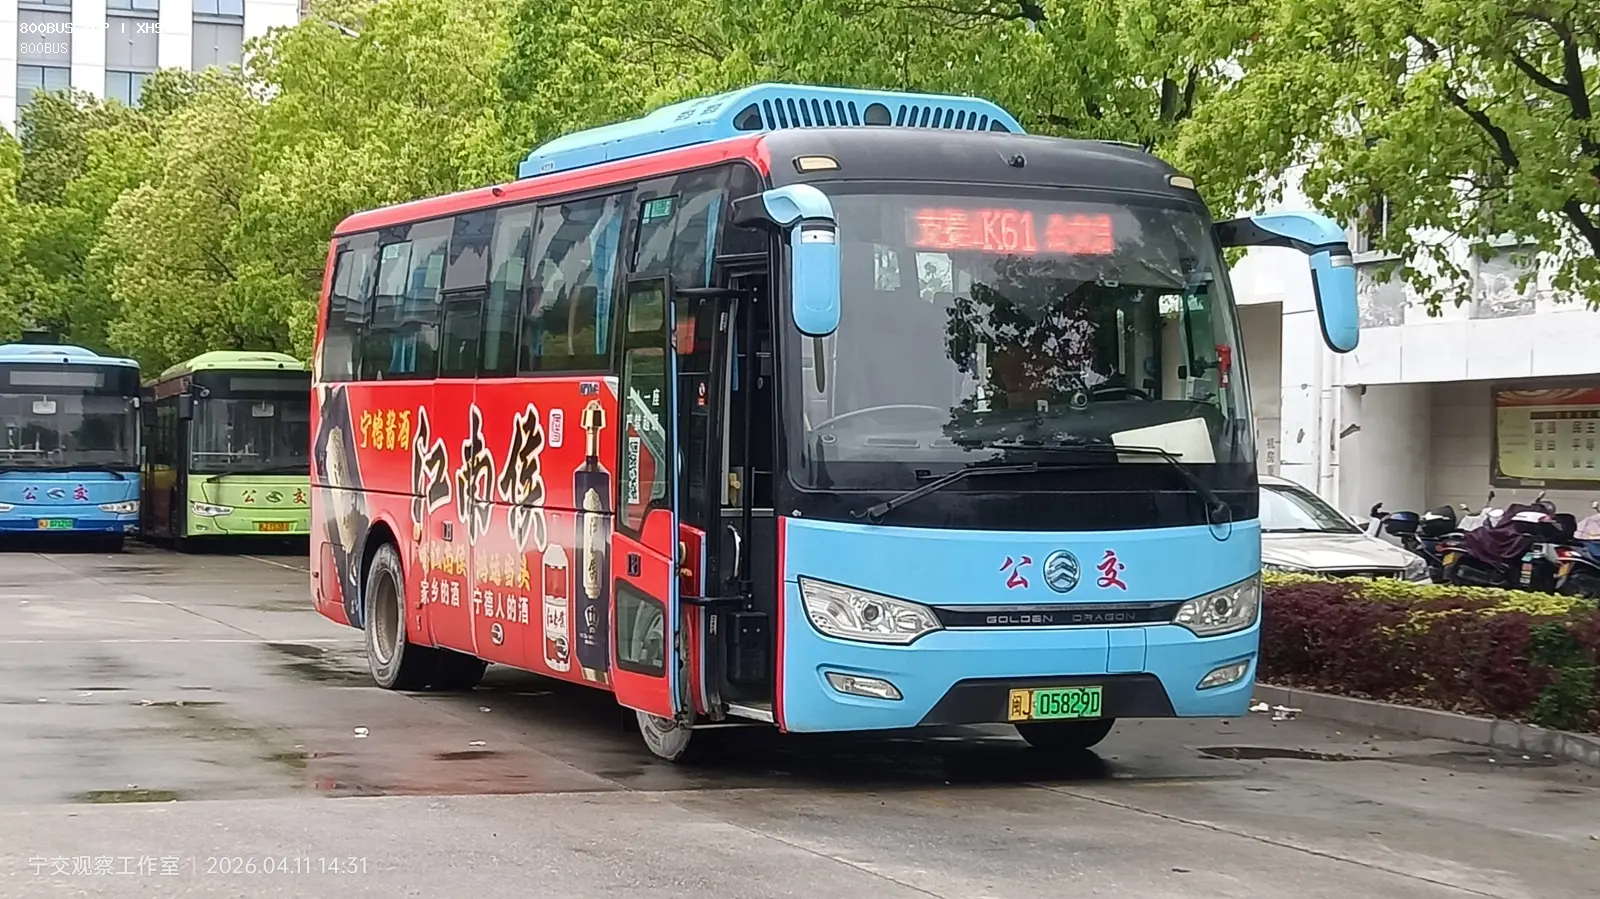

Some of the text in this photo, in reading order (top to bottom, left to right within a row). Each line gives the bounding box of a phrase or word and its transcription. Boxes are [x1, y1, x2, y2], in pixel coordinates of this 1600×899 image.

[981, 209, 1036, 251] K61
[360, 409, 412, 450] 宁德酱酒
[22, 483, 89, 501] 公 交
[241, 487, 307, 505] 公 交
[411, 403, 547, 551] 江南侯
[999, 549, 1128, 592] 公 交
[420, 578, 529, 625] 家乡的酒 宁德人的酒
[986, 612, 1136, 625] GOLDEN DRAGON
[1012, 691, 1100, 716] 闽J 05829D
